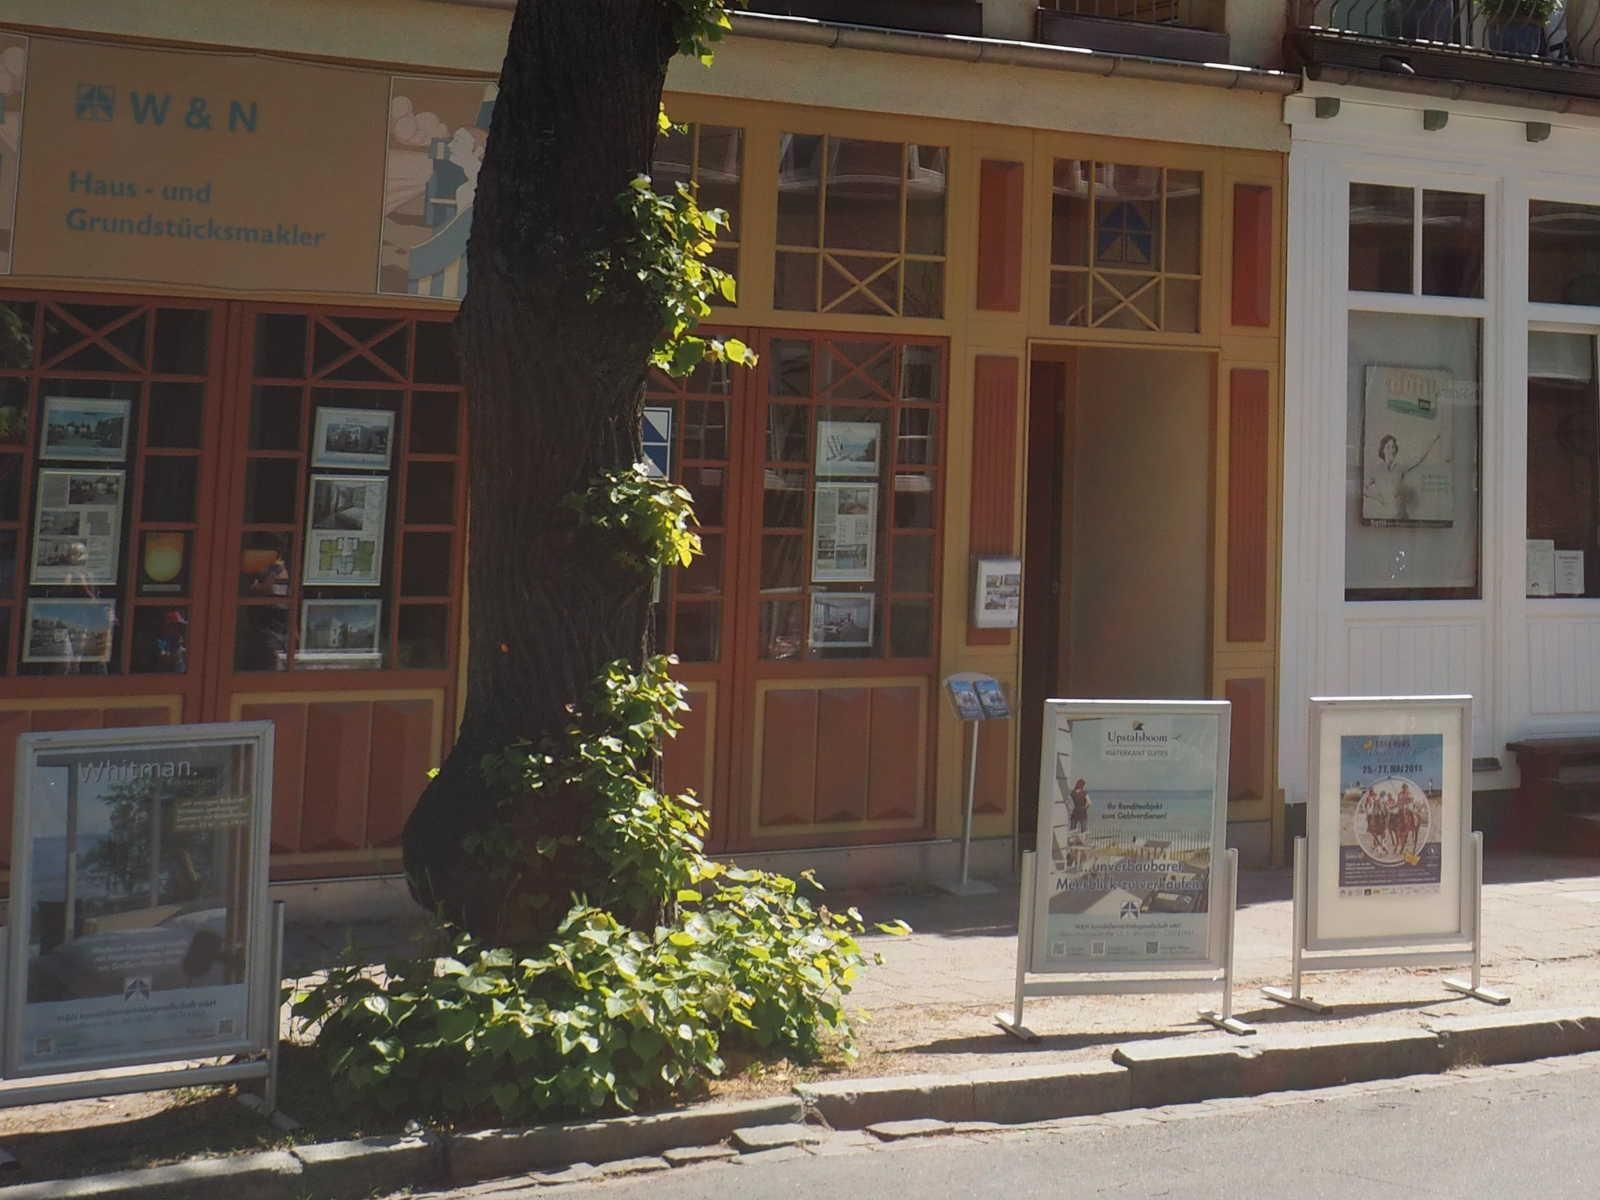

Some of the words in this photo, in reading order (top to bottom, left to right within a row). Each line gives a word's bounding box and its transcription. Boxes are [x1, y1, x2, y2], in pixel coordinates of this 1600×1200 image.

[128, 90, 172, 126] W
[184, 97, 213, 131] &
[228, 100, 259, 133] N
[162, 181, 212, 204] und
[65, 208, 327, 248] Grundstücksmakler
